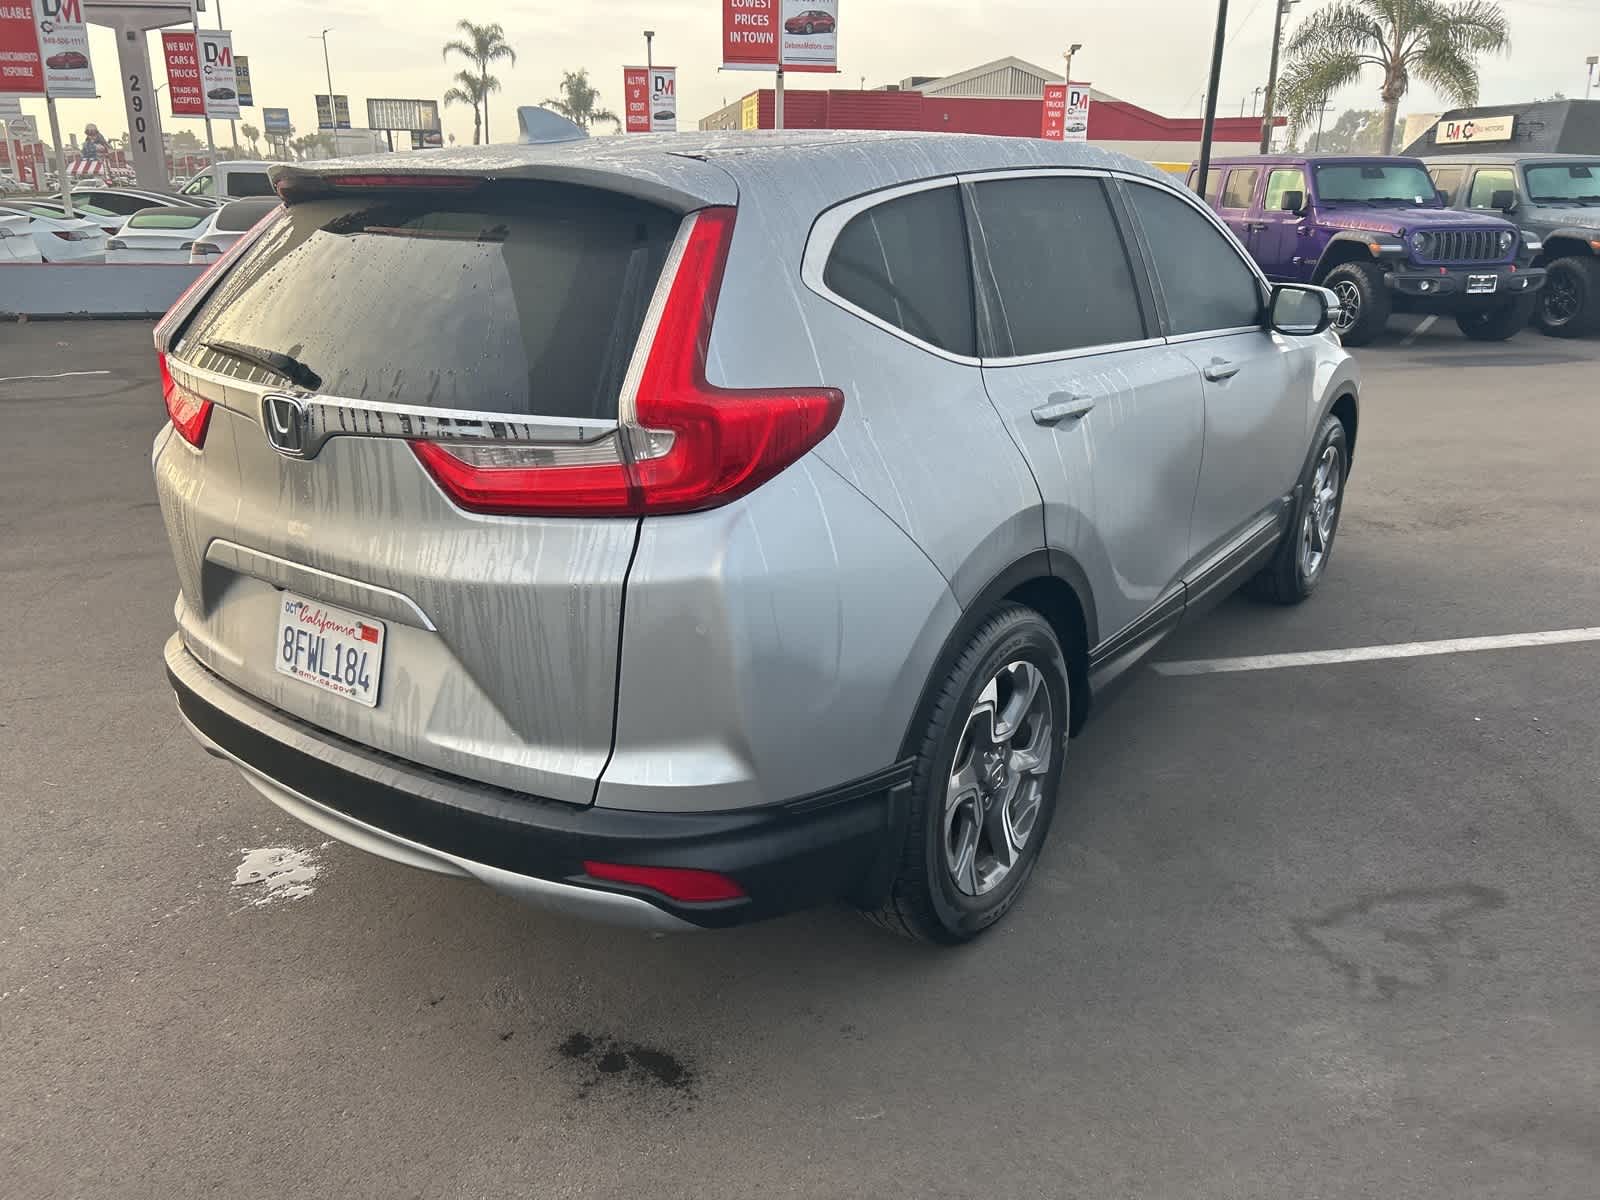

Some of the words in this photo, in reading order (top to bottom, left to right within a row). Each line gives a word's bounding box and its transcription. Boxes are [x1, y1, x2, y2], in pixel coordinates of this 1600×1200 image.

[731, 0, 771, 9] LOWEST
[734, 13, 769, 26] PRICES
[730, 32, 741, 43] IN
[743, 32, 774, 44] TOWN
[166, 42, 178, 51] WE
[179, 42, 194, 51] BUY
[169, 56, 188, 65] CARS
[189, 56, 195, 65] &
[170, 69, 198, 78] TRUCKS
[285, 601, 299, 616] OCT
[299, 604, 362, 641] California
[282, 625, 370, 693] 8FWL184
